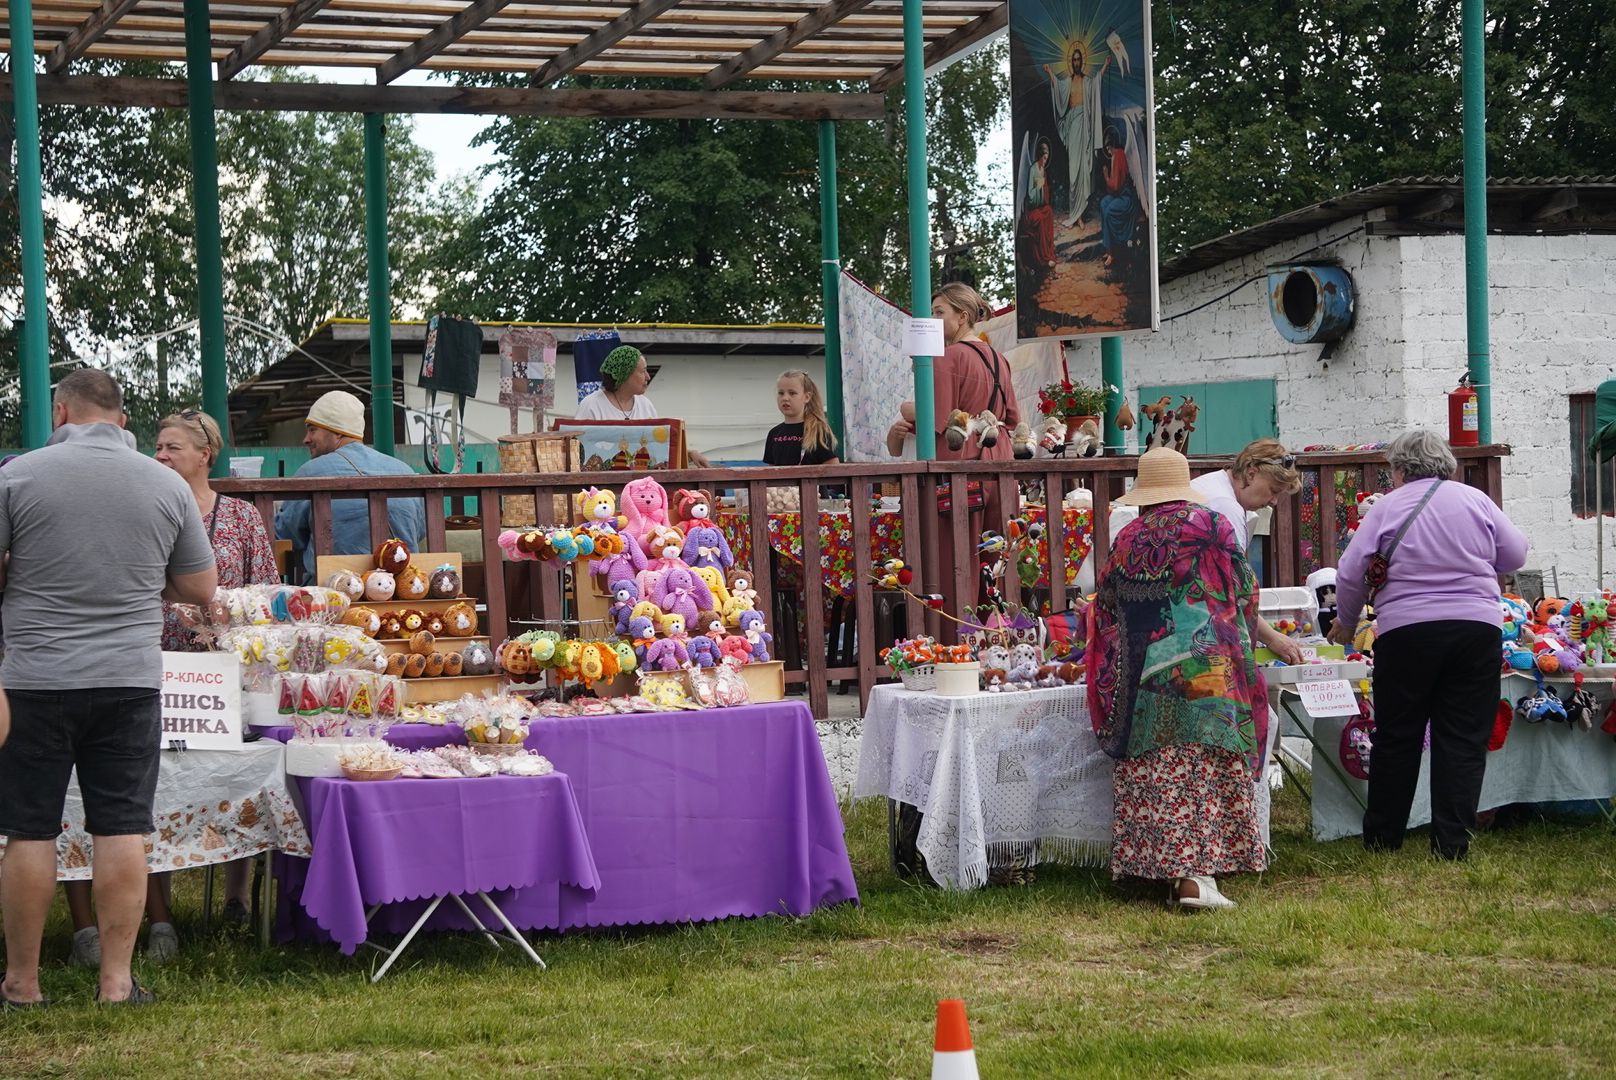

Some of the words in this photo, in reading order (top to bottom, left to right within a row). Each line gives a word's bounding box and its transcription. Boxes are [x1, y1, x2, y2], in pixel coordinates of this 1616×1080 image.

[160, 693, 226, 711] ПИСЬ
[1312, 692, 1333, 702] 100
[161, 717, 230, 734] НИКА
